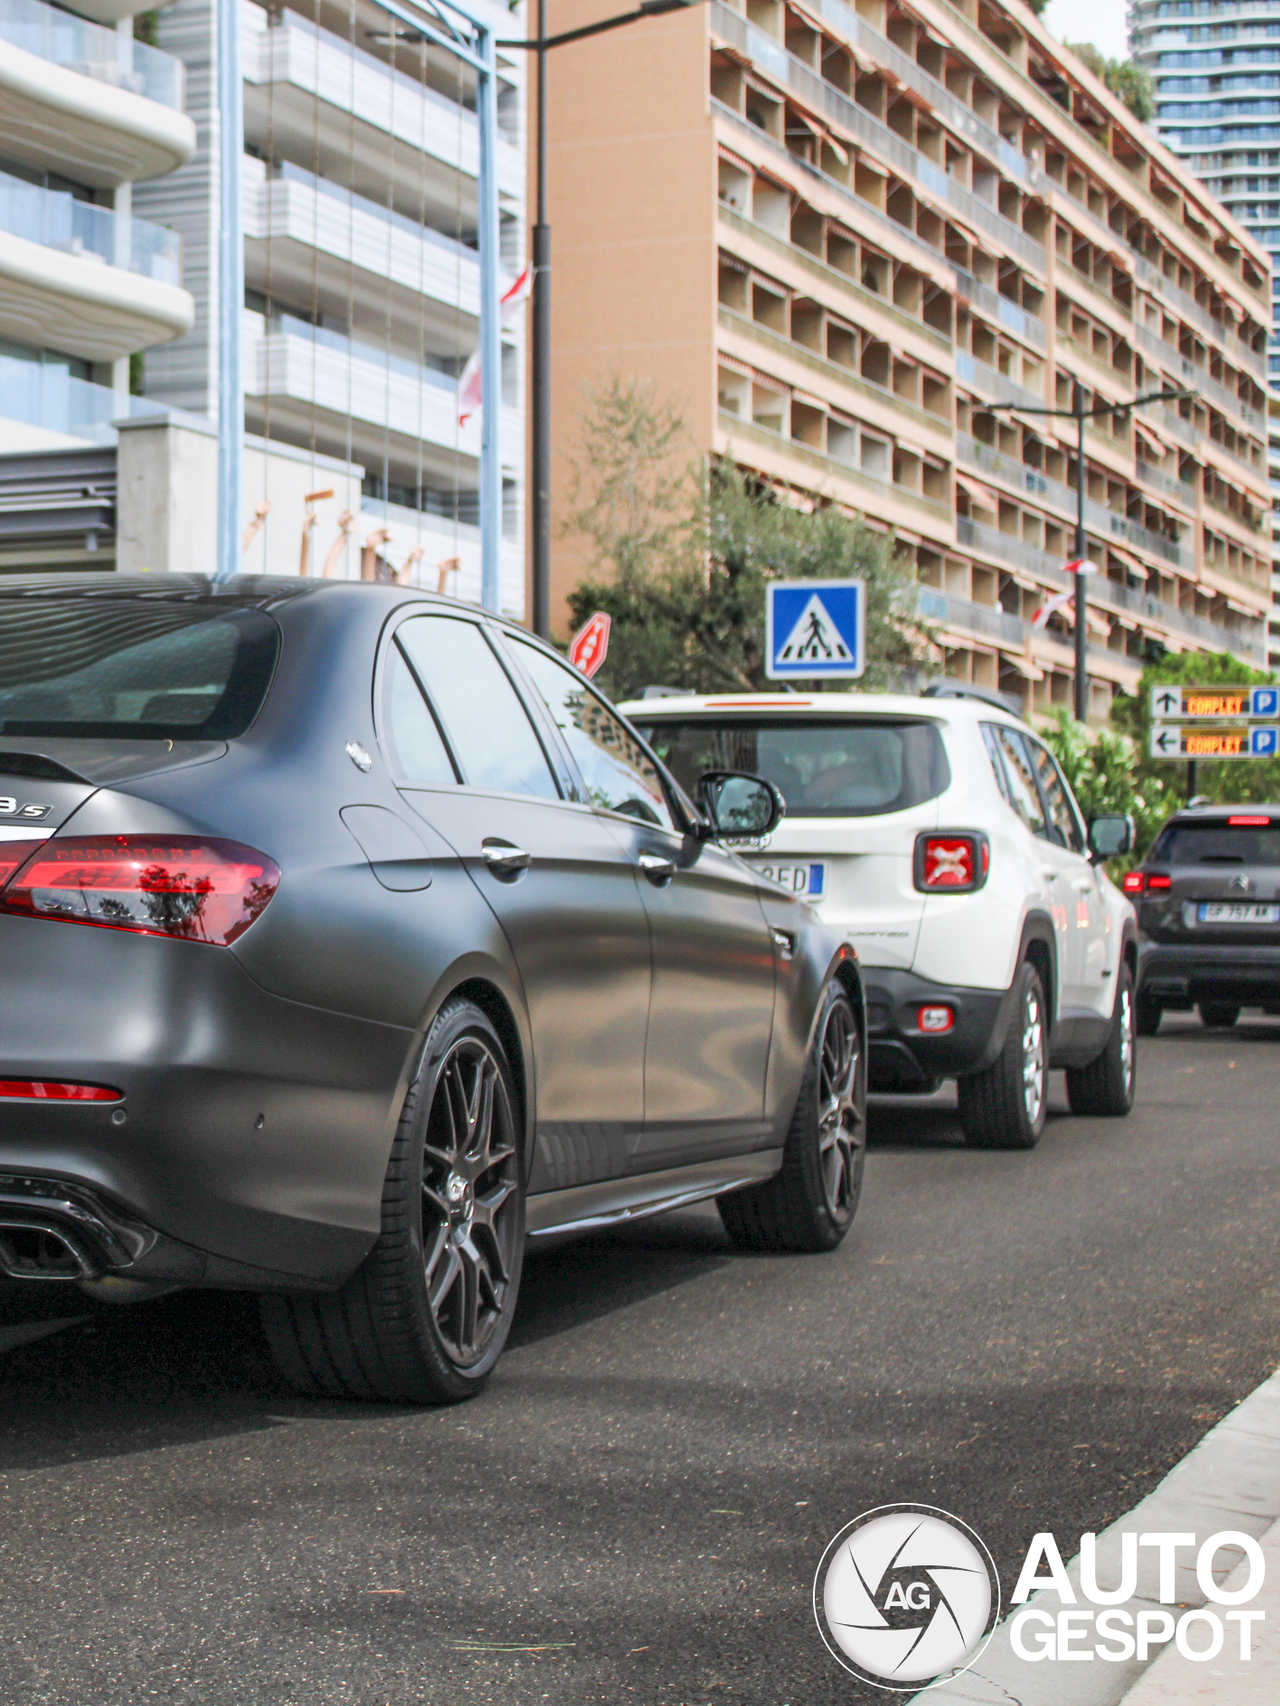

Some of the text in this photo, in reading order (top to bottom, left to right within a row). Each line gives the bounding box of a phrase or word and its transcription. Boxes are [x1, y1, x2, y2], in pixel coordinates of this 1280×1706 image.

[576, 620, 605, 671] TABA
[1186, 696, 1243, 716] COMPLET
[1258, 693, 1272, 712] P
[1186, 736, 1242, 755] COMPLET
[1257, 732, 1271, 751] P
